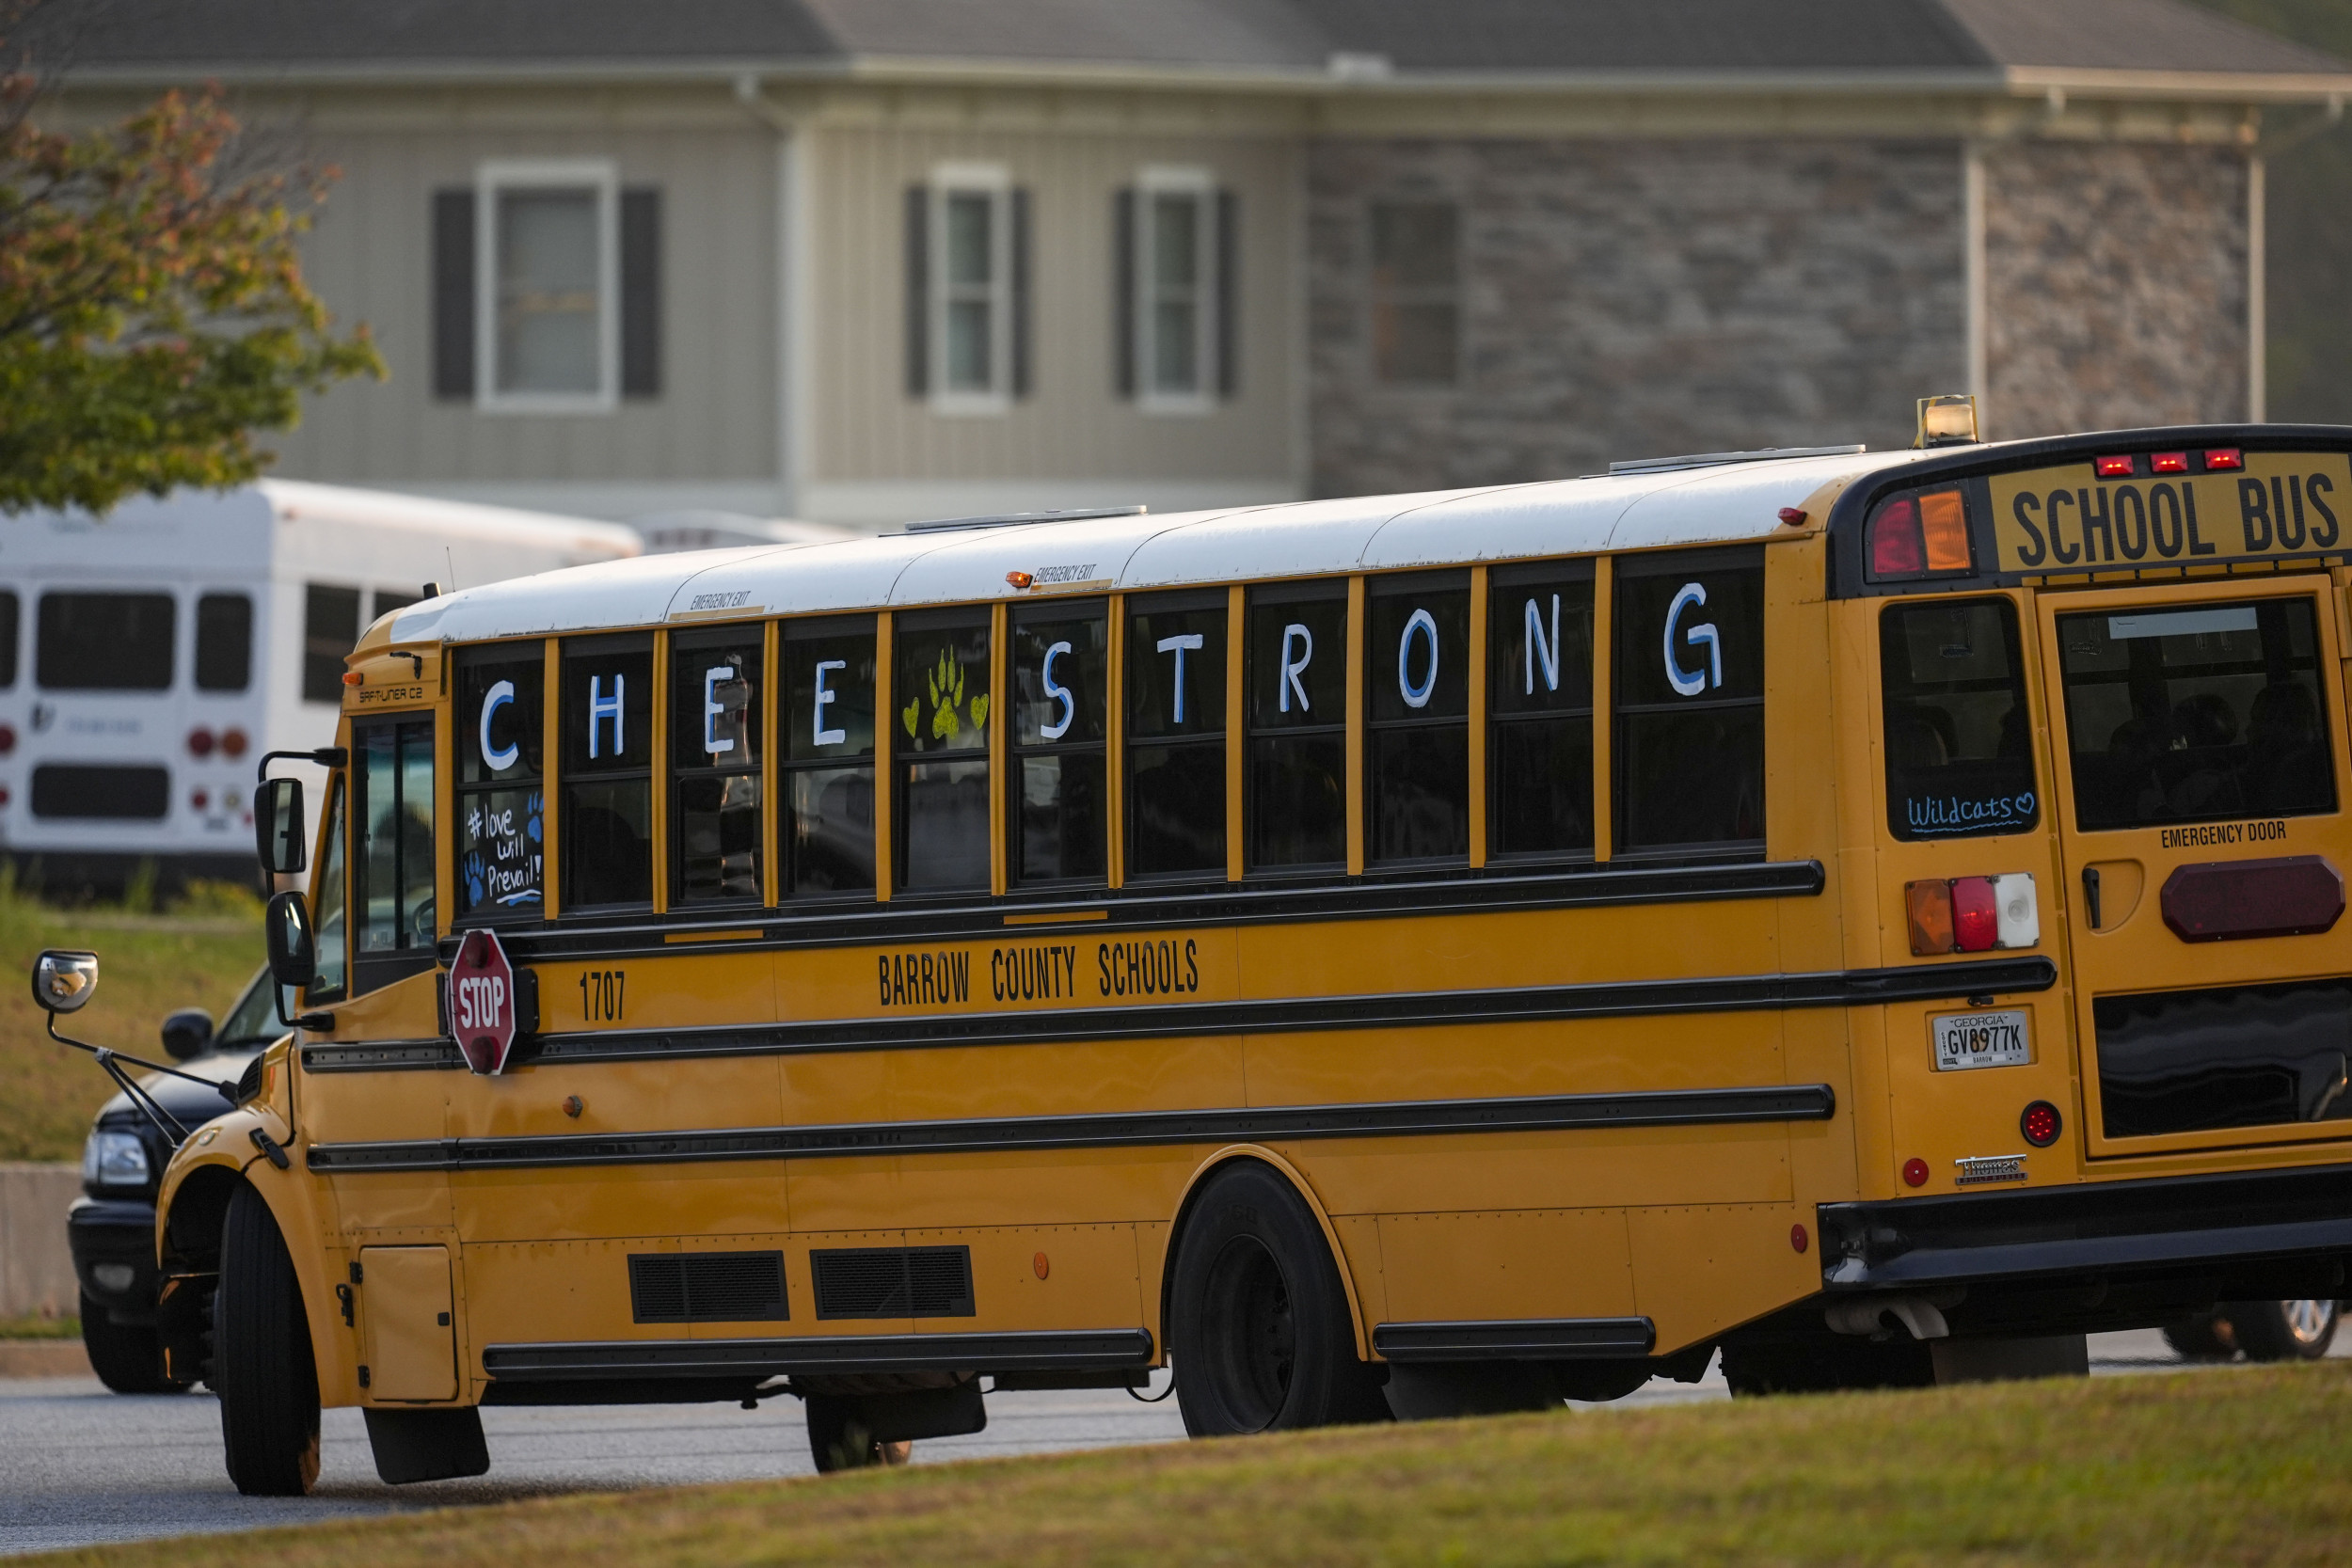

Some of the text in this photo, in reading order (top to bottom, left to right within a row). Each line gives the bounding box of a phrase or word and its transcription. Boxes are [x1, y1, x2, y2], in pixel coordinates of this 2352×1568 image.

[2012, 472, 2339, 566] SCHOOL BUS
[1034, 563, 1097, 583] EMERGENCY EXIT
[690, 590, 752, 610] EMERGENCY EXIT
[1041, 582, 1722, 738] STRONG
[409, 688, 422, 699] C2
[1908, 796, 2011, 826] Wildcats
[2161, 820, 2287, 848] EMERGENCY DOOR
[487, 854, 542, 897] Prevail!
[879, 938, 1199, 1006] BARROW COUNTY SCHOOLS
[459, 975, 505, 1029] STOP
[580, 970, 625, 1022] 1707
[1954, 1015, 2005, 1028] GEORGIA
[1947, 1024, 2023, 1055] GV8977K
[1973, 1055, 1993, 1064] BARROW
[1956, 1155, 2026, 1178] Thomas
